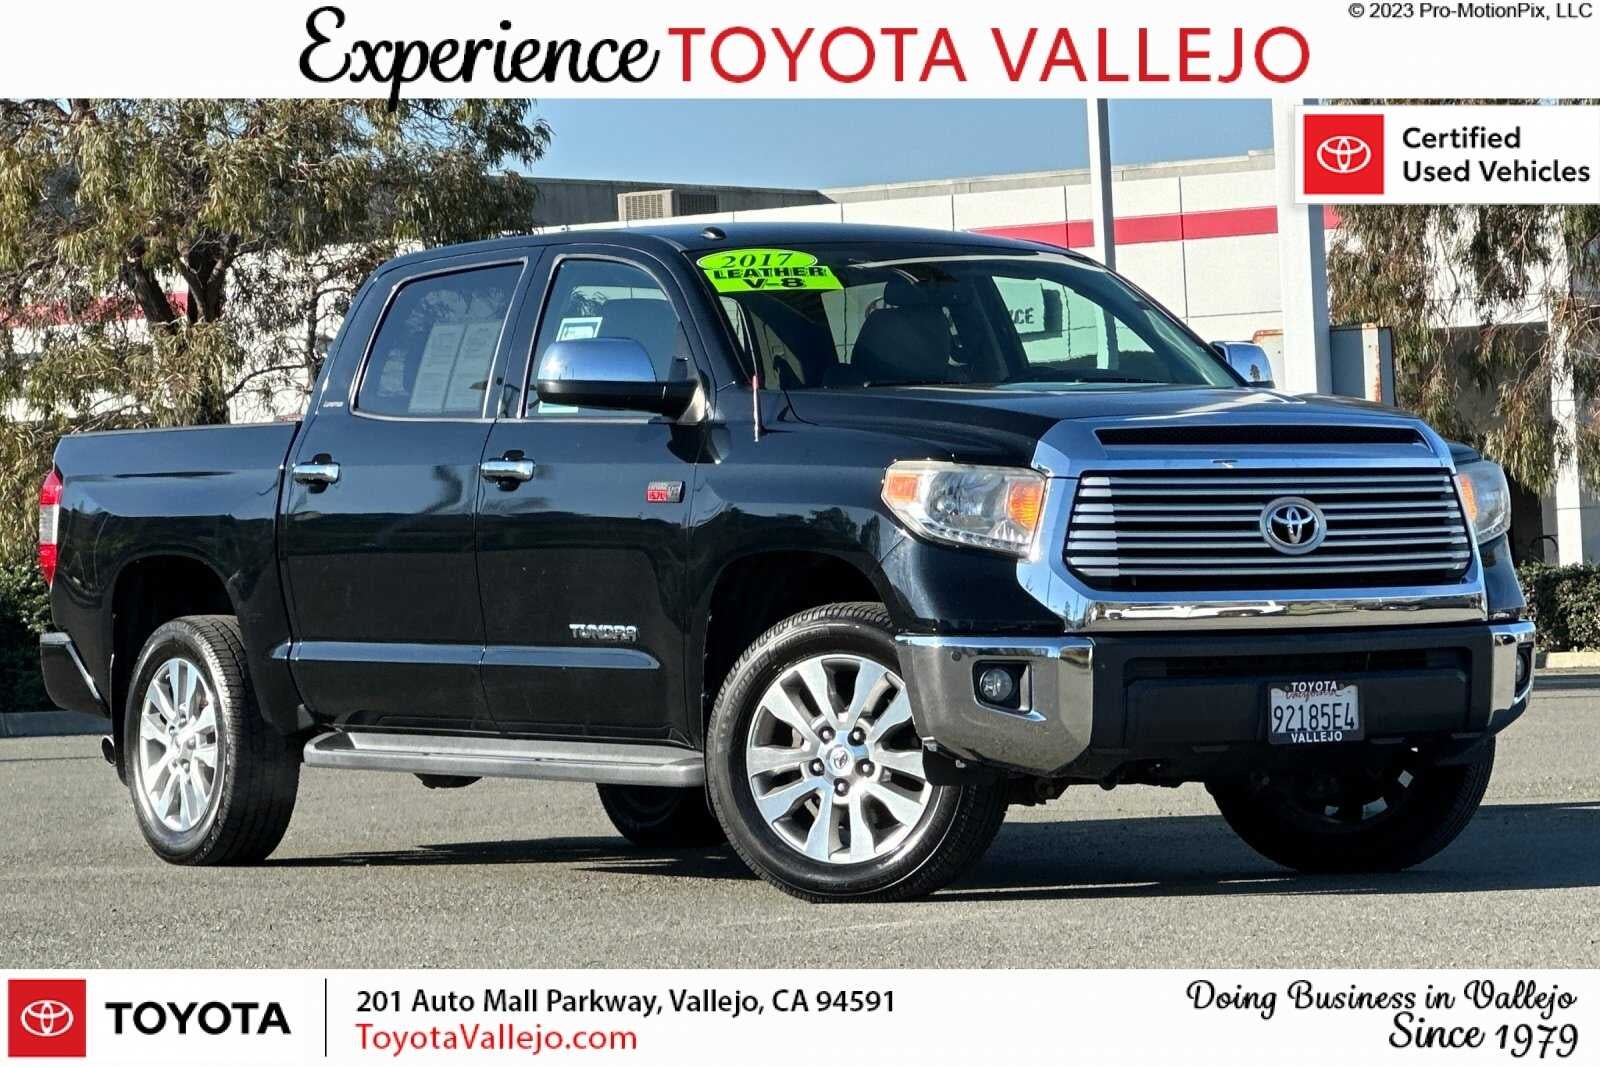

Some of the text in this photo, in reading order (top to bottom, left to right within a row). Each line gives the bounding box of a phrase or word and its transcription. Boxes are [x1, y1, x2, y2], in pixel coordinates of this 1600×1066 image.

[720, 253, 793, 268] 2017
[713, 266, 827, 280] LEATHER
[743, 277, 804, 289] V-8
[569, 624, 637, 641] TUNDRA
[1291, 681, 1337, 692] TOYOTA
[1273, 702, 1355, 733] 92185E4
[1291, 731, 1343, 743] VALLEJO
